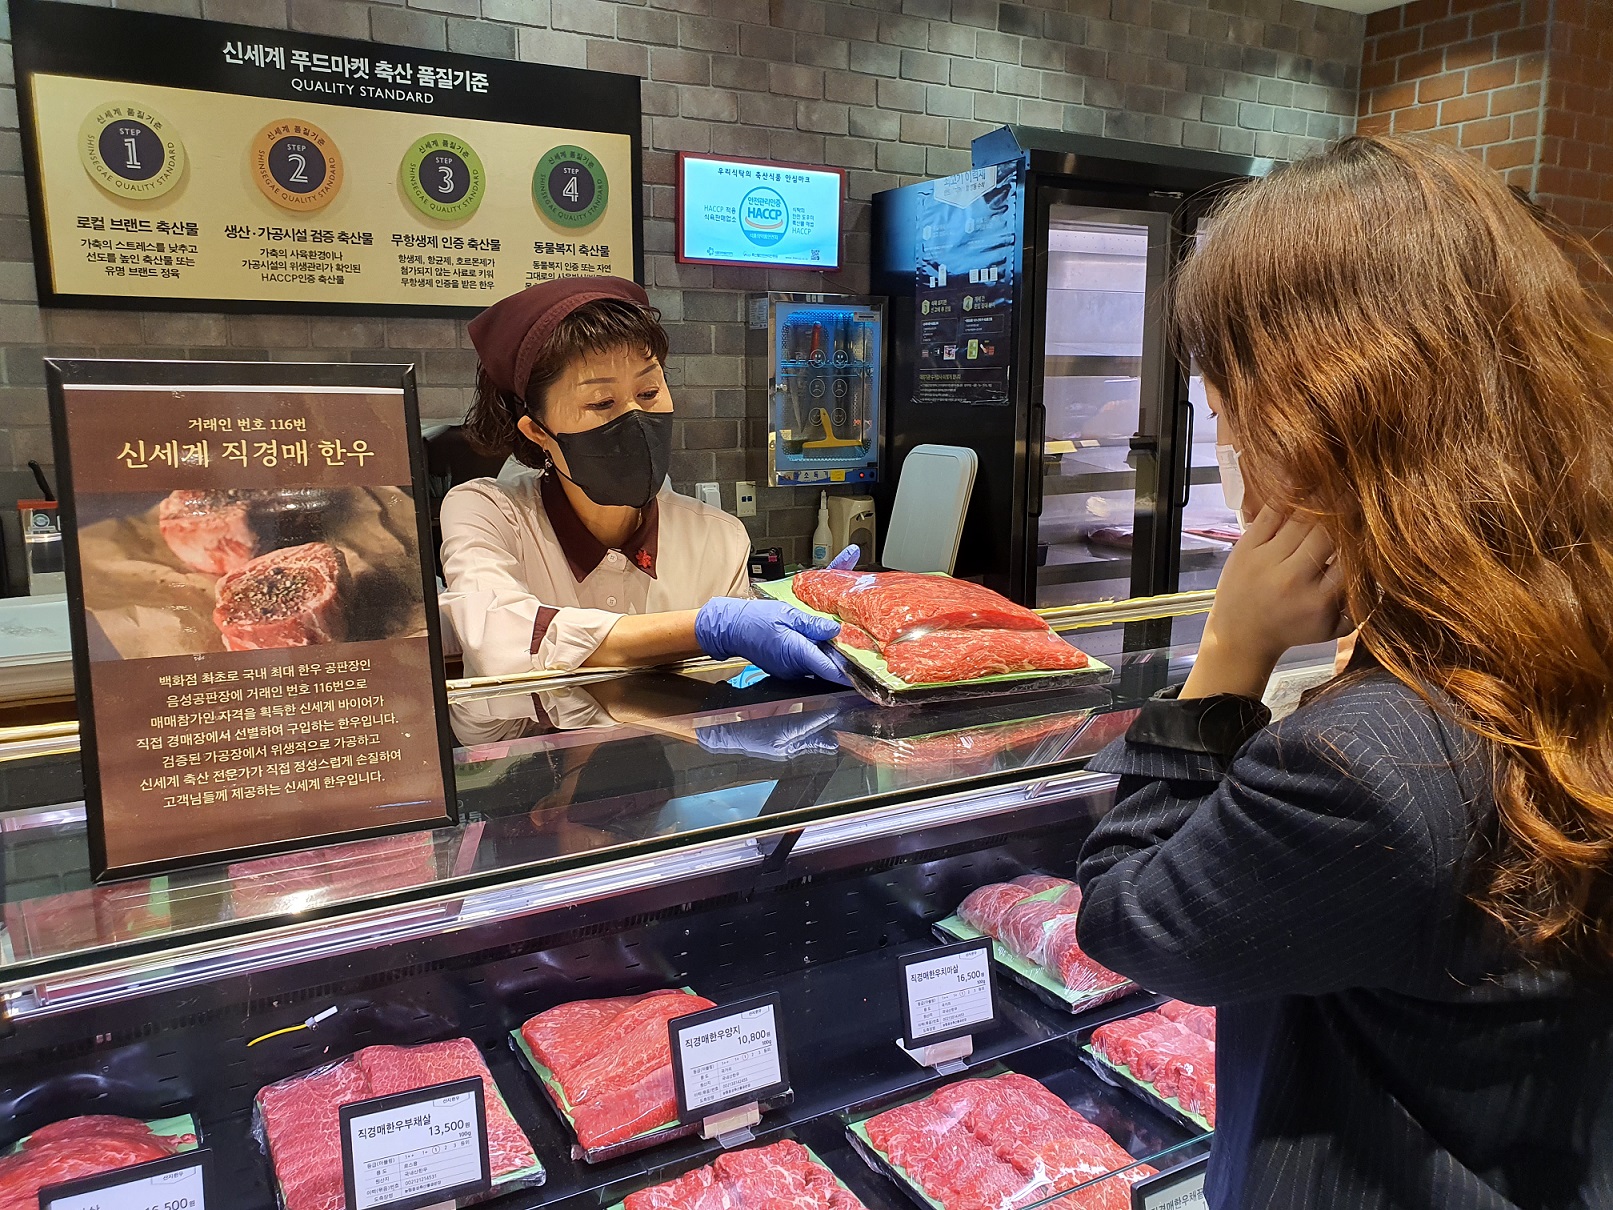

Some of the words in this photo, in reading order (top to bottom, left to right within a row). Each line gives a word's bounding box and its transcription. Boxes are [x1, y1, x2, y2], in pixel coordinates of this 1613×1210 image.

[223, 41, 286, 70] 신세계
[290, 49, 369, 79] 푸드마켓
[374, 60, 412, 85] 축산
[416, 65, 489, 94] 품질기준
[291, 78, 354, 96] QUALITY
[360, 86, 434, 104] STANDARD
[97, 108, 123, 124] 신세계
[127, 107, 163, 130] 품질기준
[119, 128, 141, 136] STEP
[267, 125, 290, 141] 신세계
[294, 125, 326, 146] 품질기준
[124, 137, 141, 169] 1
[286, 144, 307, 152] STEP
[418, 139, 440, 154] 신세계
[87, 134, 114, 181] SHINSEGAE
[115, 180, 156, 191] QUALITY
[157, 142, 176, 185] STANDARD
[288, 153, 308, 183] 2
[258, 150, 280, 194] SHINSEGAE
[281, 193, 317, 204] QUALITY
[318, 157, 336, 198] STANDARD
[438, 166, 455, 194] 3
[718, 167, 752, 178] 우리식탁의
[755, 171, 782, 182] 축산식품
[785, 174, 811, 183] 안심마크
[409, 163, 428, 204] SHINSEGAE
[430, 203, 462, 213] QUALITY
[462, 169, 479, 207] STANDARD
[562, 176, 579, 202] 4
[704, 205, 724, 213] HACCP
[747, 207, 782, 221] HACCP
[77, 216, 105, 231] 로컬
[110, 218, 153, 232] 브랜드
[156, 221, 199, 236] 축산물
[792, 227, 811, 235] HACCP
[80, 239, 112, 250] 가축의
[115, 240, 165, 253] 스트레스를
[168, 243, 198, 254] 낮추고
[310, 229, 335, 244] 검증
[337, 231, 374, 246] 축산물
[391, 234, 438, 249] 무항생제
[441, 236, 464, 250] 인증
[467, 238, 501, 252] 축산물
[260, 248, 288, 259] 가축의
[290, 249, 343, 261] 사육환경이나
[533, 241, 576, 256] 동물복지
[579, 244, 610, 257] 축산물
[86, 252, 117, 263] 선도를
[119, 253, 140, 264] 높인
[143, 255, 173, 266] 축산물
[176, 256, 196, 267] 또는
[242, 260, 287, 271] 가공시설의
[289, 261, 333, 272] 위생관리가
[335, 263, 361, 274] 확인된
[398, 254, 425, 265] 항생제,
[427, 255, 454, 266] 항균제,
[456, 257, 496, 267] 호르몬제가
[532, 260, 563, 271] 동물복지
[564, 262, 579, 272] 인증
[580, 263, 596, 273] 또는
[596, 264, 612, 273] 자연
[105, 266, 125, 277] 유명
[128, 267, 158, 277] 브랜드
[160, 268, 180, 279] 정육
[261, 273, 316, 284] HACCP인증
[318, 274, 345, 285] 축산물
[400, 266, 433, 276] 첨가되지
[434, 267, 451, 277] 않는
[453, 268, 477, 278] 사료로
[478, 269, 494, 279] 키워
[400, 278, 434, 288] 무항생제
[435, 279, 459, 288] 인증을
[461, 280, 477, 289] 받은
[479, 280, 495, 290] 한우
[188, 417, 233, 432] 거래인
[237, 417, 266, 432] 번호
[270, 417, 307, 432] 116번
[117, 439, 209, 469] 신세계
[221, 438, 309, 468] 직경매
[317, 439, 375, 467] 한우
[159, 673, 198, 688] 백화점
[201, 670, 240, 684] 최초로
[242, 667, 267, 681] 국내
[270, 664, 295, 679] 최대
[298, 663, 322, 677] 한우
[324, 659, 371, 674] 공판장인
[166, 688, 243, 708] 음성공판장에
[246, 685, 283, 700] 거래인
[286, 683, 311, 697] 번호
[313, 678, 368, 693] 116번으로
[150, 711, 216, 729] 매매참가인
[218, 707, 256, 722] 자격을
[259, 703, 296, 718] 획득한
[299, 699, 335, 715] 신세계
[338, 695, 385, 710] 바이어가
[136, 736, 163, 750] 직접
[167, 729, 231, 748] 경매장에서
[234, 724, 284, 741] 선별하여
[287, 720, 335, 735] 구입하는
[337, 712, 399, 730] 한우입니다.
[162, 752, 201, 769] 검증된
[204, 744, 267, 763] 가공장에서
[270, 739, 331, 756] 위생적으로
[334, 733, 381, 749] 가공하고
[140, 775, 180, 791] 신세계
[183, 771, 209, 786] 축산
[266, 762, 291, 776] 직접
[294, 754, 353, 772] 정성스럽게
[356, 749, 402, 766] 손질하여
[163, 788, 228, 808] 고객님들께
[231, 783, 281, 800] 제공하는
[284, 777, 320, 794] 신세계
[324, 770, 385, 789] 한우입니다.
[910, 964, 959, 983] 직경매한우치마살
[685, 1024, 741, 1049] 직경매한우양지
[357, 1113, 431, 1140] 직경매한우부채살
